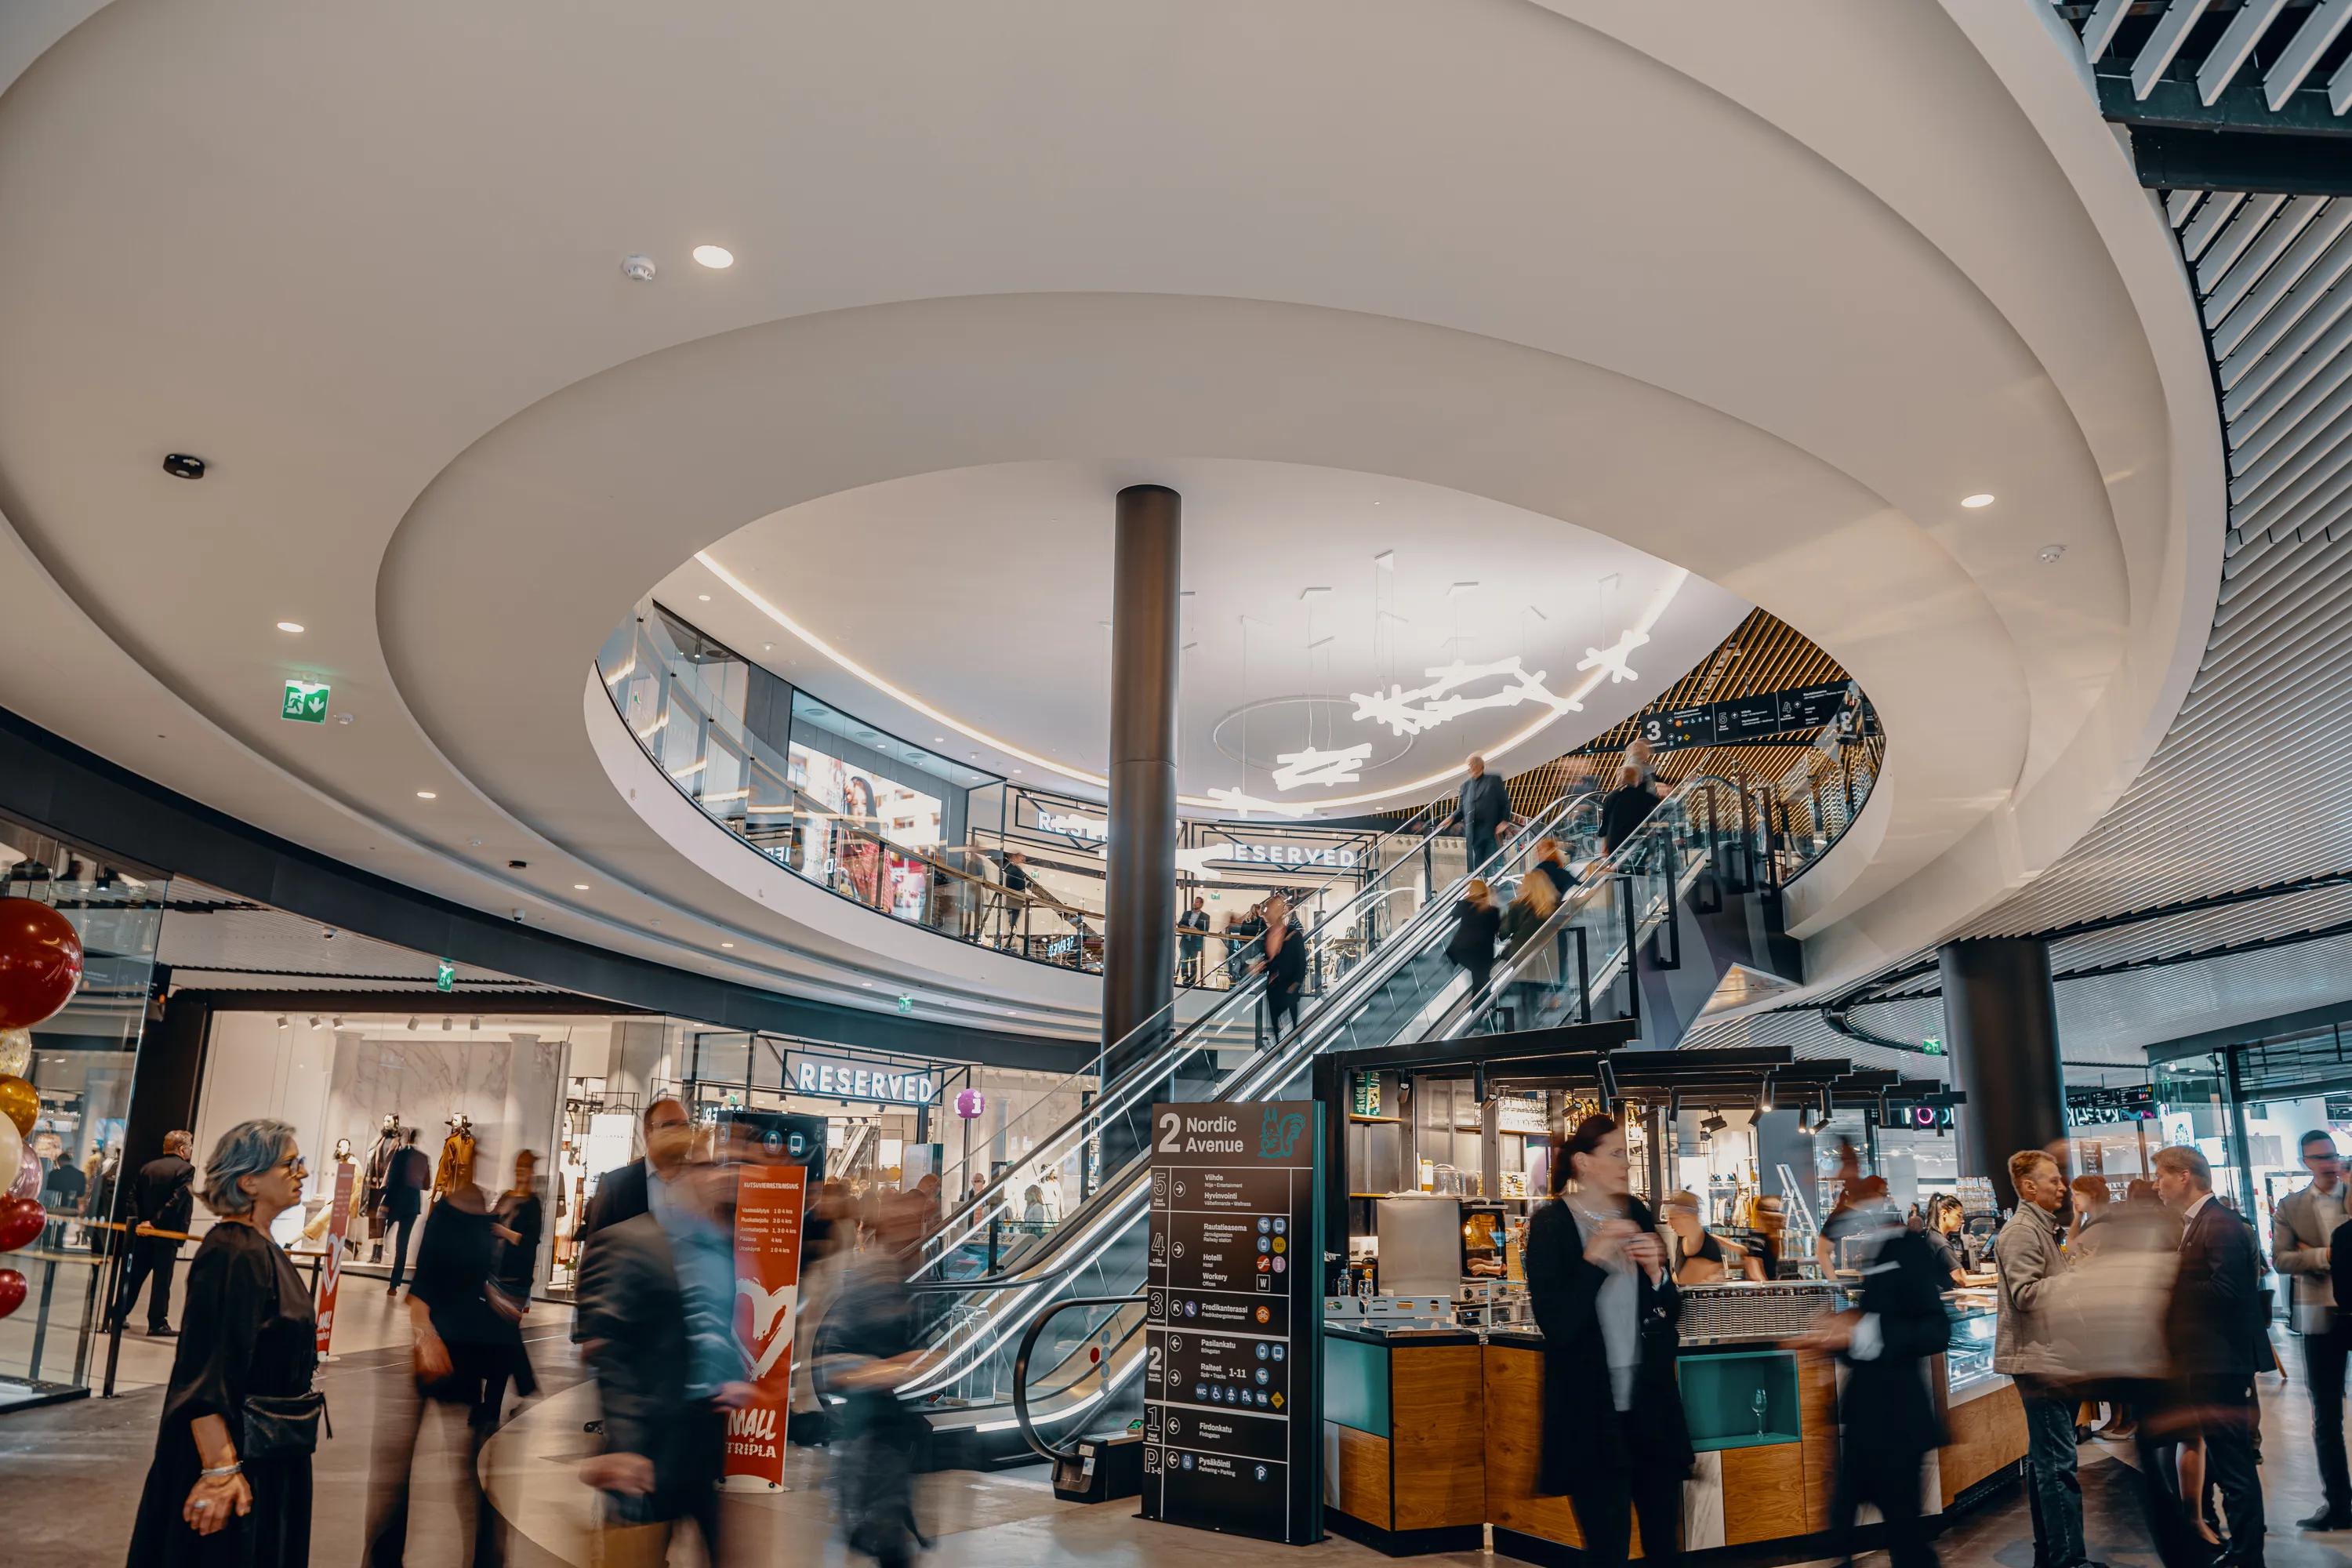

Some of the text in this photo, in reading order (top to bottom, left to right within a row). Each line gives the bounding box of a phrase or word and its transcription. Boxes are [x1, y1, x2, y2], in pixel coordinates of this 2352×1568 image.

[1719, 712, 1728, 724] 5
[1646, 720, 1661, 741] 3
[1231, 844, 1356, 867] ESERVED
[800, 1063, 932, 1102] RESERVED
[1158, 1112, 1181, 1152] 2
[1186, 1116, 1237, 1133] Nordic
[1185, 1137, 1243, 1152] Avenue
[1153, 1172, 1167, 1196] 5
[1204, 1192, 1238, 1200] Hyvinvointi
[1203, 1223, 1247, 1232] Rautatieasema
[1151, 1232, 1165, 1256] 4
[1203, 1272, 1228, 1282] Workery
[1149, 1291, 1163, 1316] 3
[1202, 1303, 1248, 1313] Fredikanterassi
[1201, 1339, 1236, 1348] Pasilankatu
[1148, 1346, 1162, 1370] 2
[1200, 1363, 1247, 1378] Raiteet 1-11
[728, 1408, 777, 1441] MALL
[1147, 1406, 1160, 1431] 1
[1200, 1422, 1232, 1433] Firdonkatu
[725, 1443, 777, 1458] TRIPLA
[1144, 1447, 1159, 1473] P
[1199, 1457, 1231, 1468] Pysäköinti
